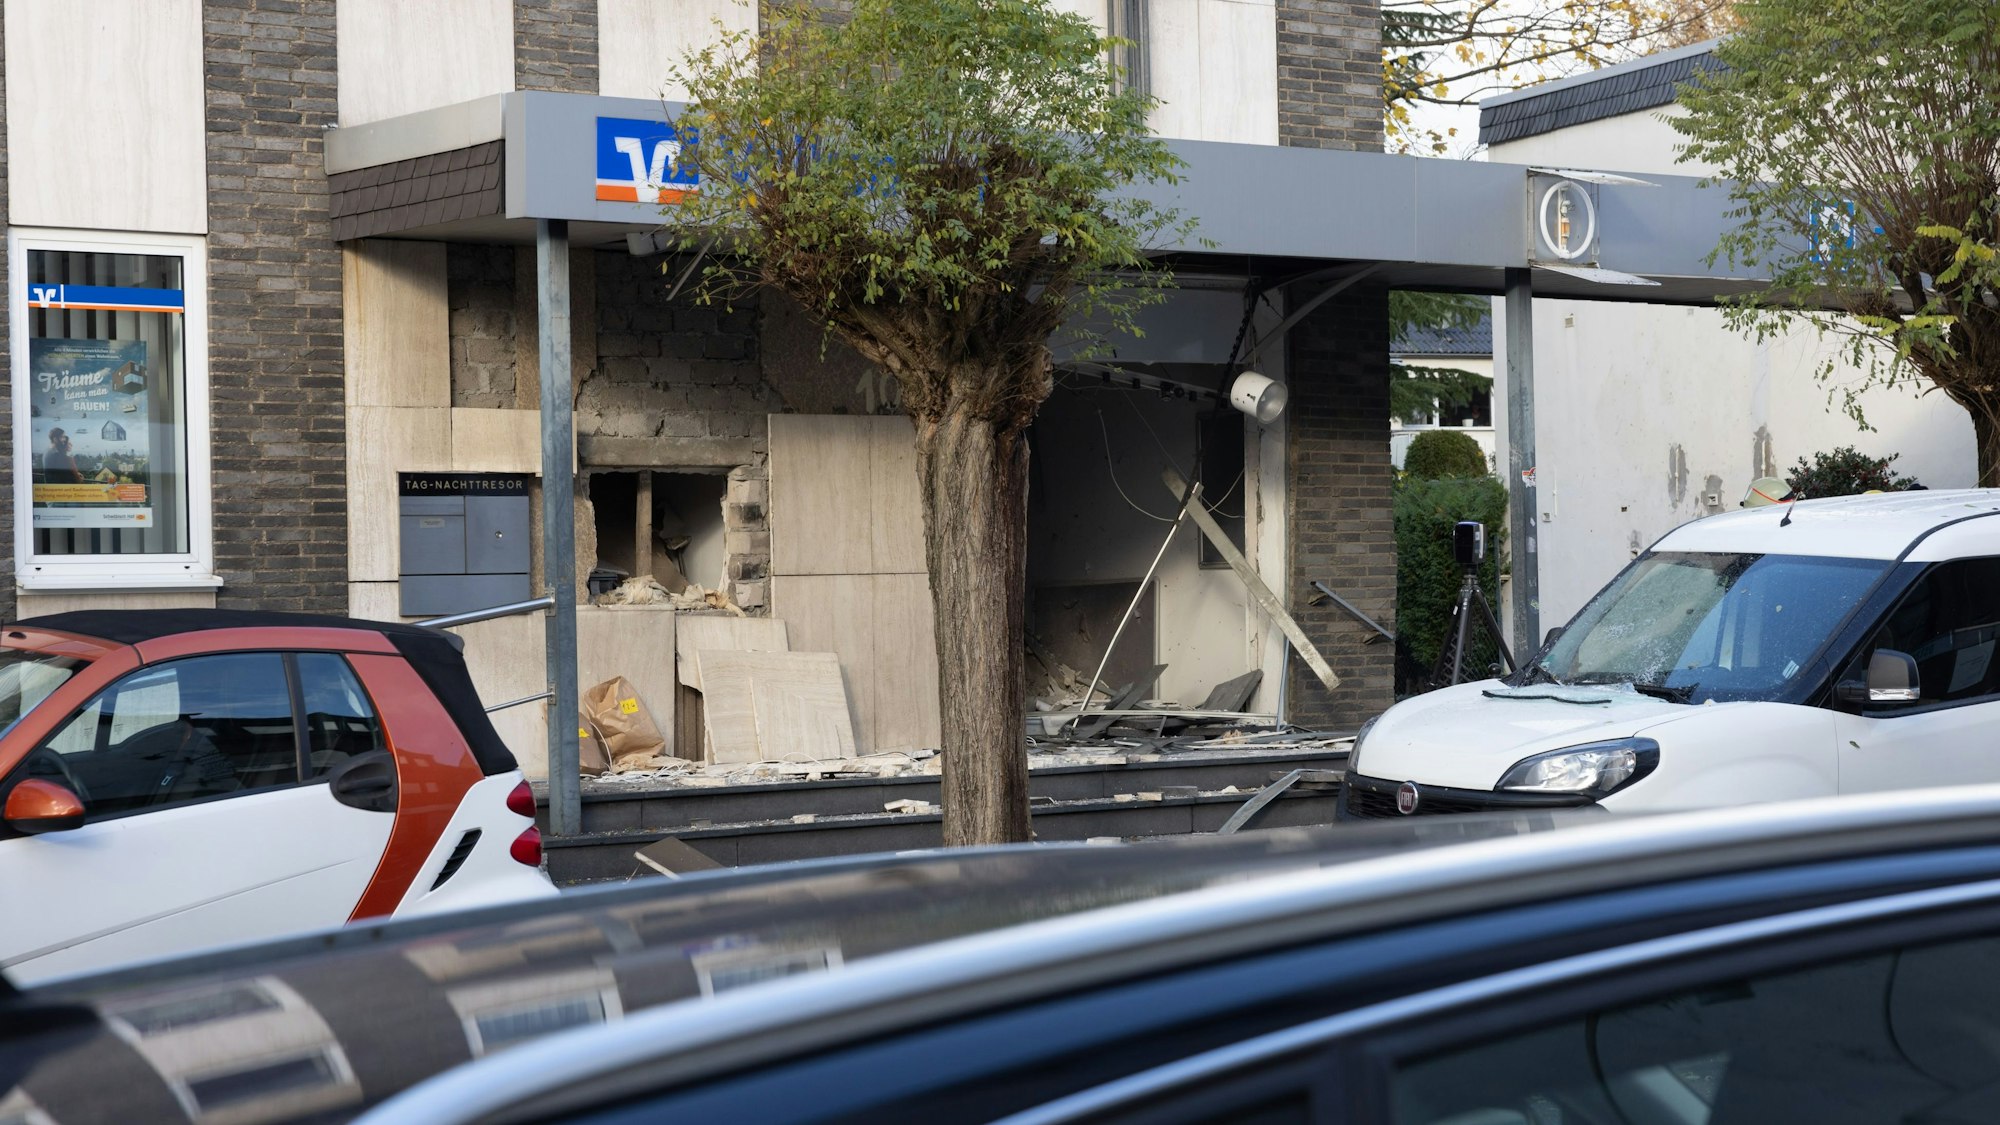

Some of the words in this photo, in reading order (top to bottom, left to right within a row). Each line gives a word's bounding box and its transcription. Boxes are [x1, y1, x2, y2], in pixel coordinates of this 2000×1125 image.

[38, 369, 106, 393] Träume
[64, 390, 87, 400] kann
[88, 388, 108, 397] man
[73, 402, 110, 411] BAUEN!
[405, 480, 523, 489] TAG-NACHTTRESOR
[1401, 791, 1413, 806] FIAT
